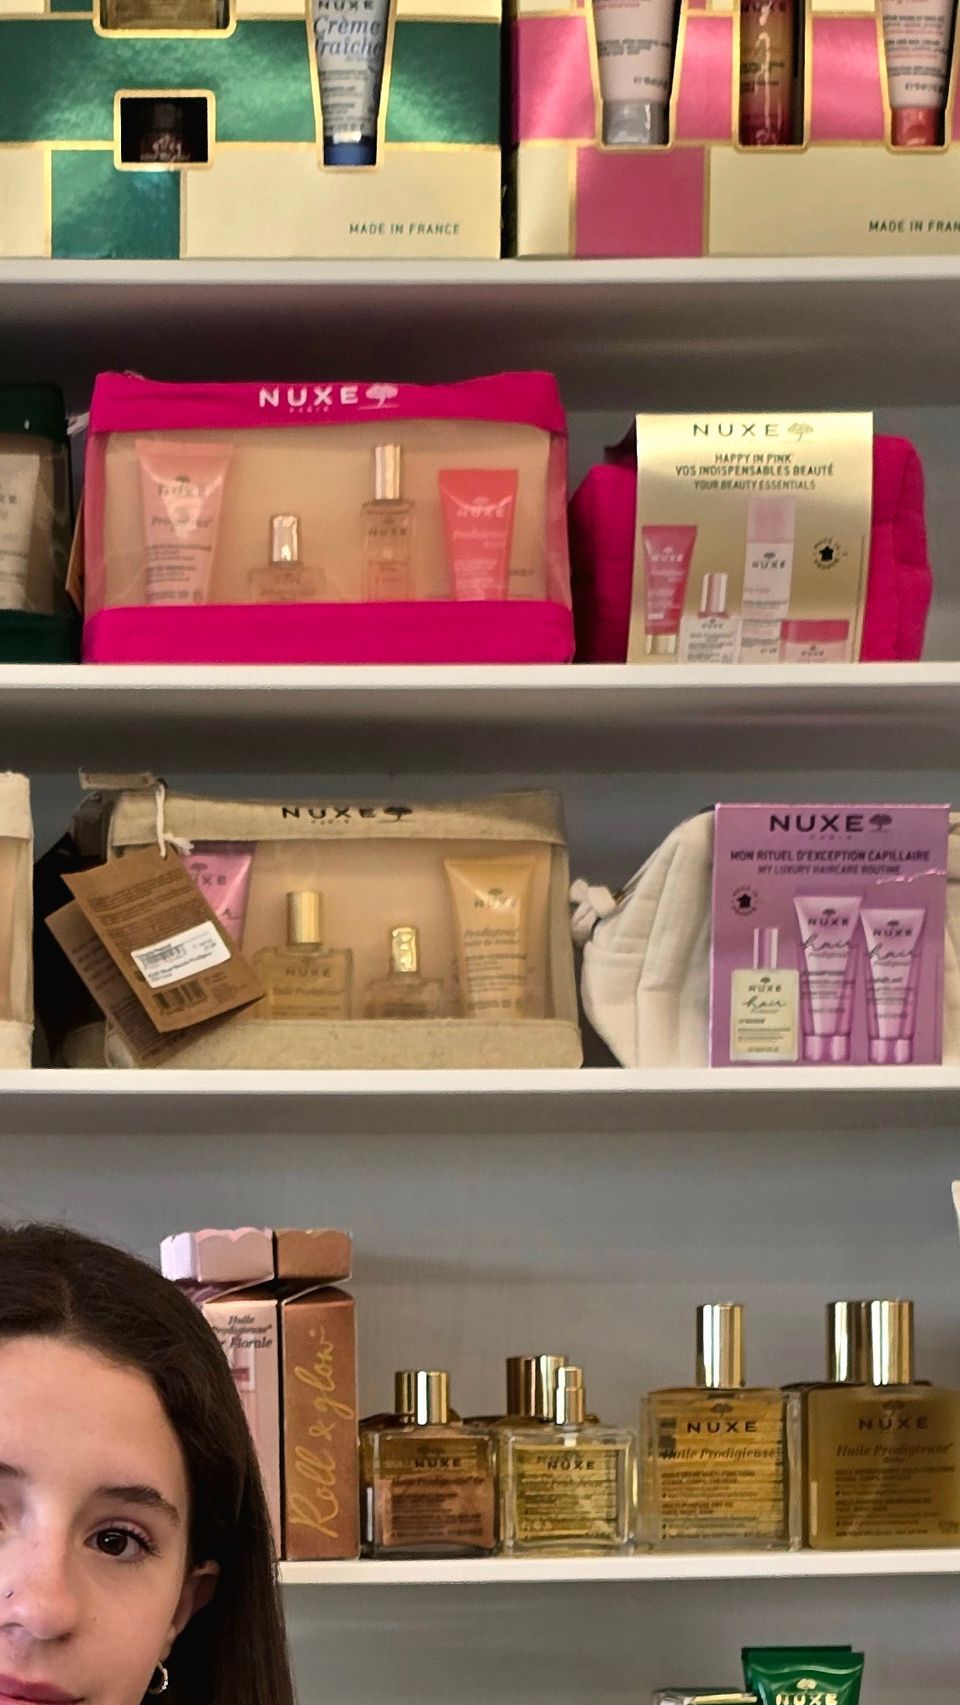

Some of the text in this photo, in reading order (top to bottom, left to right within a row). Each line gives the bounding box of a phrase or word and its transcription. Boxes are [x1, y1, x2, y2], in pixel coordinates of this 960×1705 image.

[349, 222, 460, 236] MADE IN FRANCE
[869, 220, 903, 233] MADE
[908, 220, 924, 233] IN
[259, 385, 359, 408] NUXE
[693, 423, 781, 437] NUXE
[715, 454, 751, 463] HAPPY
[753, 454, 764, 463] IN
[675, 463, 834, 476] VOS INDISPENSABLES BEAUTÉ
[694, 480, 816, 490] YOUR BEAUTY ESSENTIALS
[752, 559, 786, 570] NUXE
[281, 806, 377, 820] NUXE
[770, 814, 864, 832] NUXE
[730, 850, 930, 862] MON RITUEL D'EXCEPTION CAPILLAIRE
[758, 865, 772, 874] MY
[813, 865, 859, 874] HAIRCARE
[808, 917, 850, 927] NUXE
[873, 928, 913, 938] NUXE
[687, 1421, 758, 1433] NUXE
[859, 1417, 929, 1430] NUXE
[308, 1421, 335, 1445] &
[415, 1458, 462, 1468] NUXE
[547, 1460, 595, 1471] NUXE
